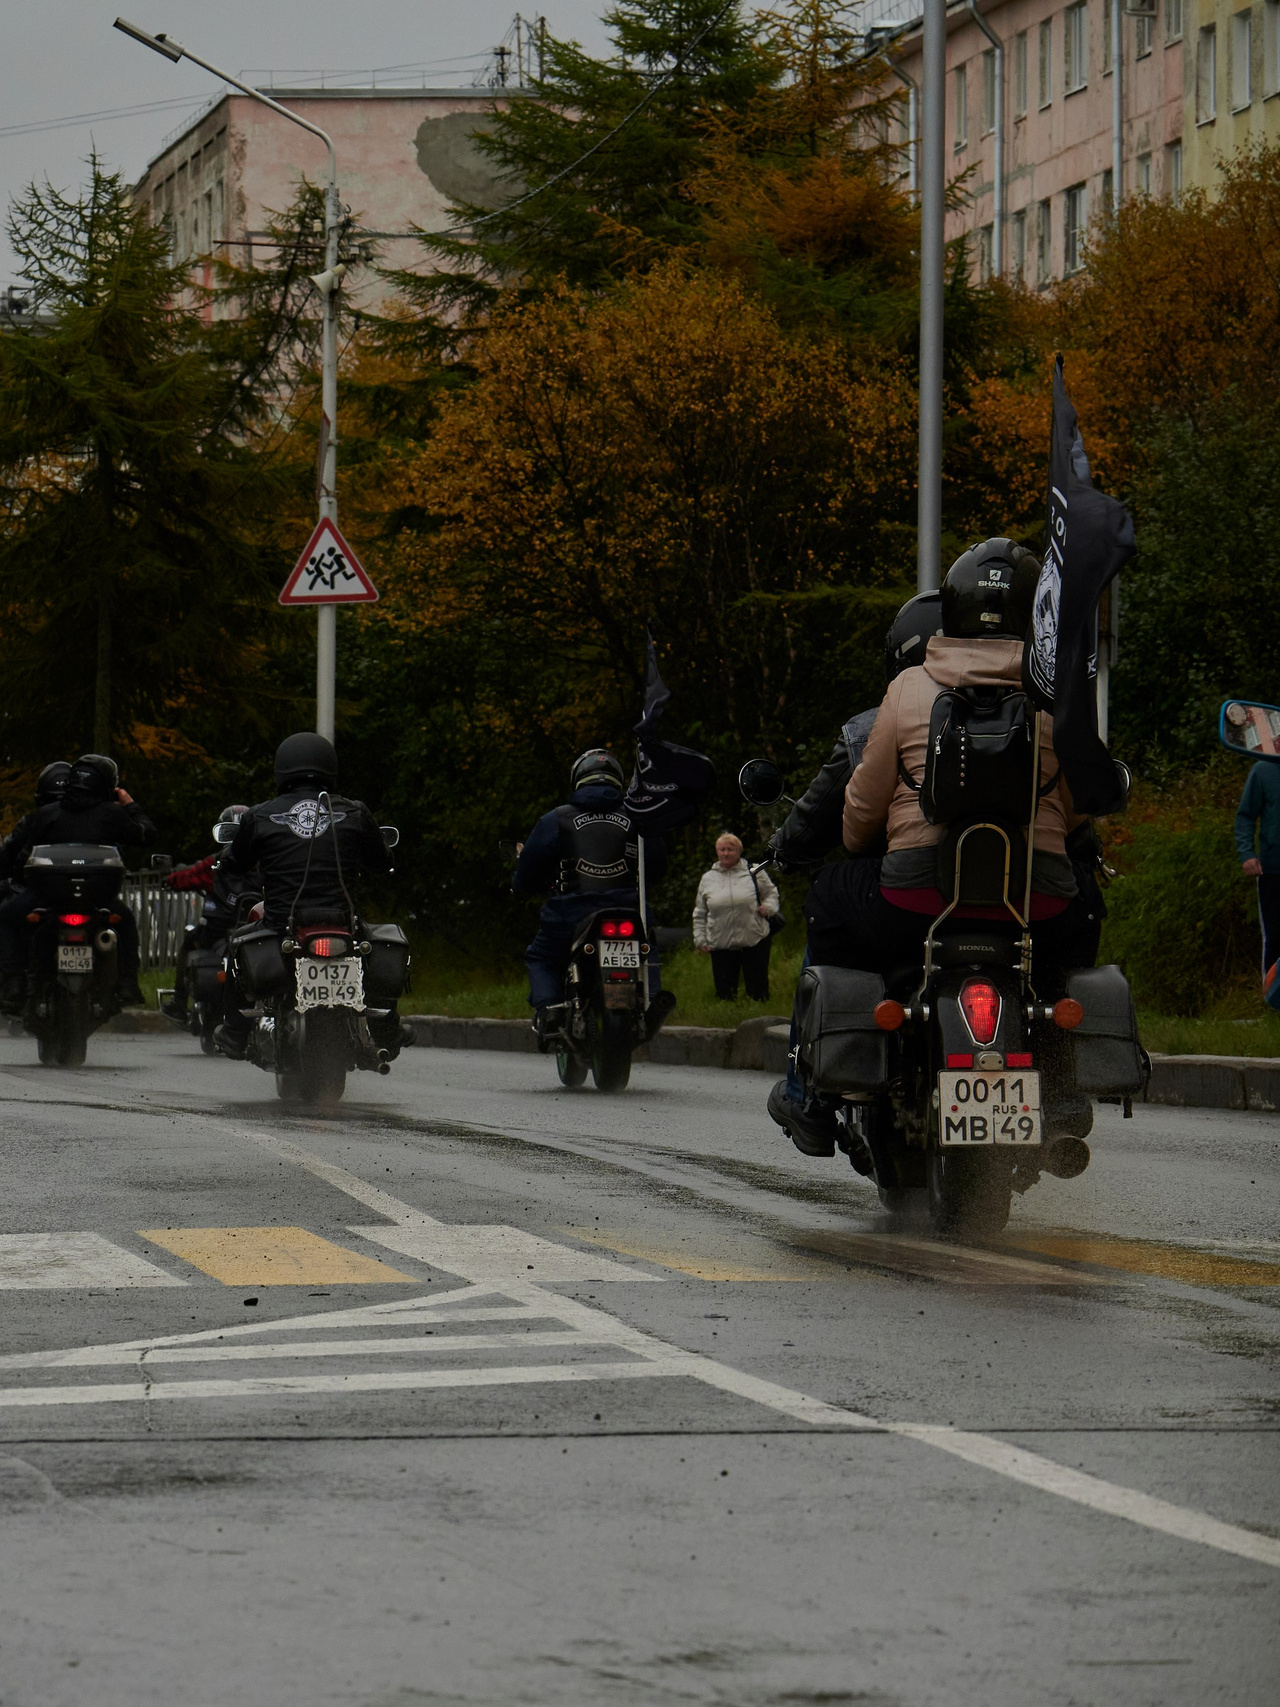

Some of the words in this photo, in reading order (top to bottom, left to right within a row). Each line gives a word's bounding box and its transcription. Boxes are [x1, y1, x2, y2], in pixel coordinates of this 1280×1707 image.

[977, 580, 1010, 590] SHARK
[577, 813, 604, 826] POLAR
[605, 813, 628, 827] OWLS
[580, 864, 625, 875] MAGADAN
[62, 947, 87, 956] 0117
[604, 941, 633, 952] 7771
[958, 945, 996, 953] HONDA
[60, 960, 75, 968] MC
[77, 960, 90, 969] 49
[602, 956, 619, 966] AE
[622, 956, 637, 967] 25
[308, 965, 350, 980] 0137
[302, 986, 329, 1001] MB
[335, 986, 356, 1000] 49
[955, 1078, 1024, 1103] 0011
[992, 1105, 1018, 1114] RUS
[945, 1116, 988, 1141] MB
[1000, 1116, 1034, 1141] 49
